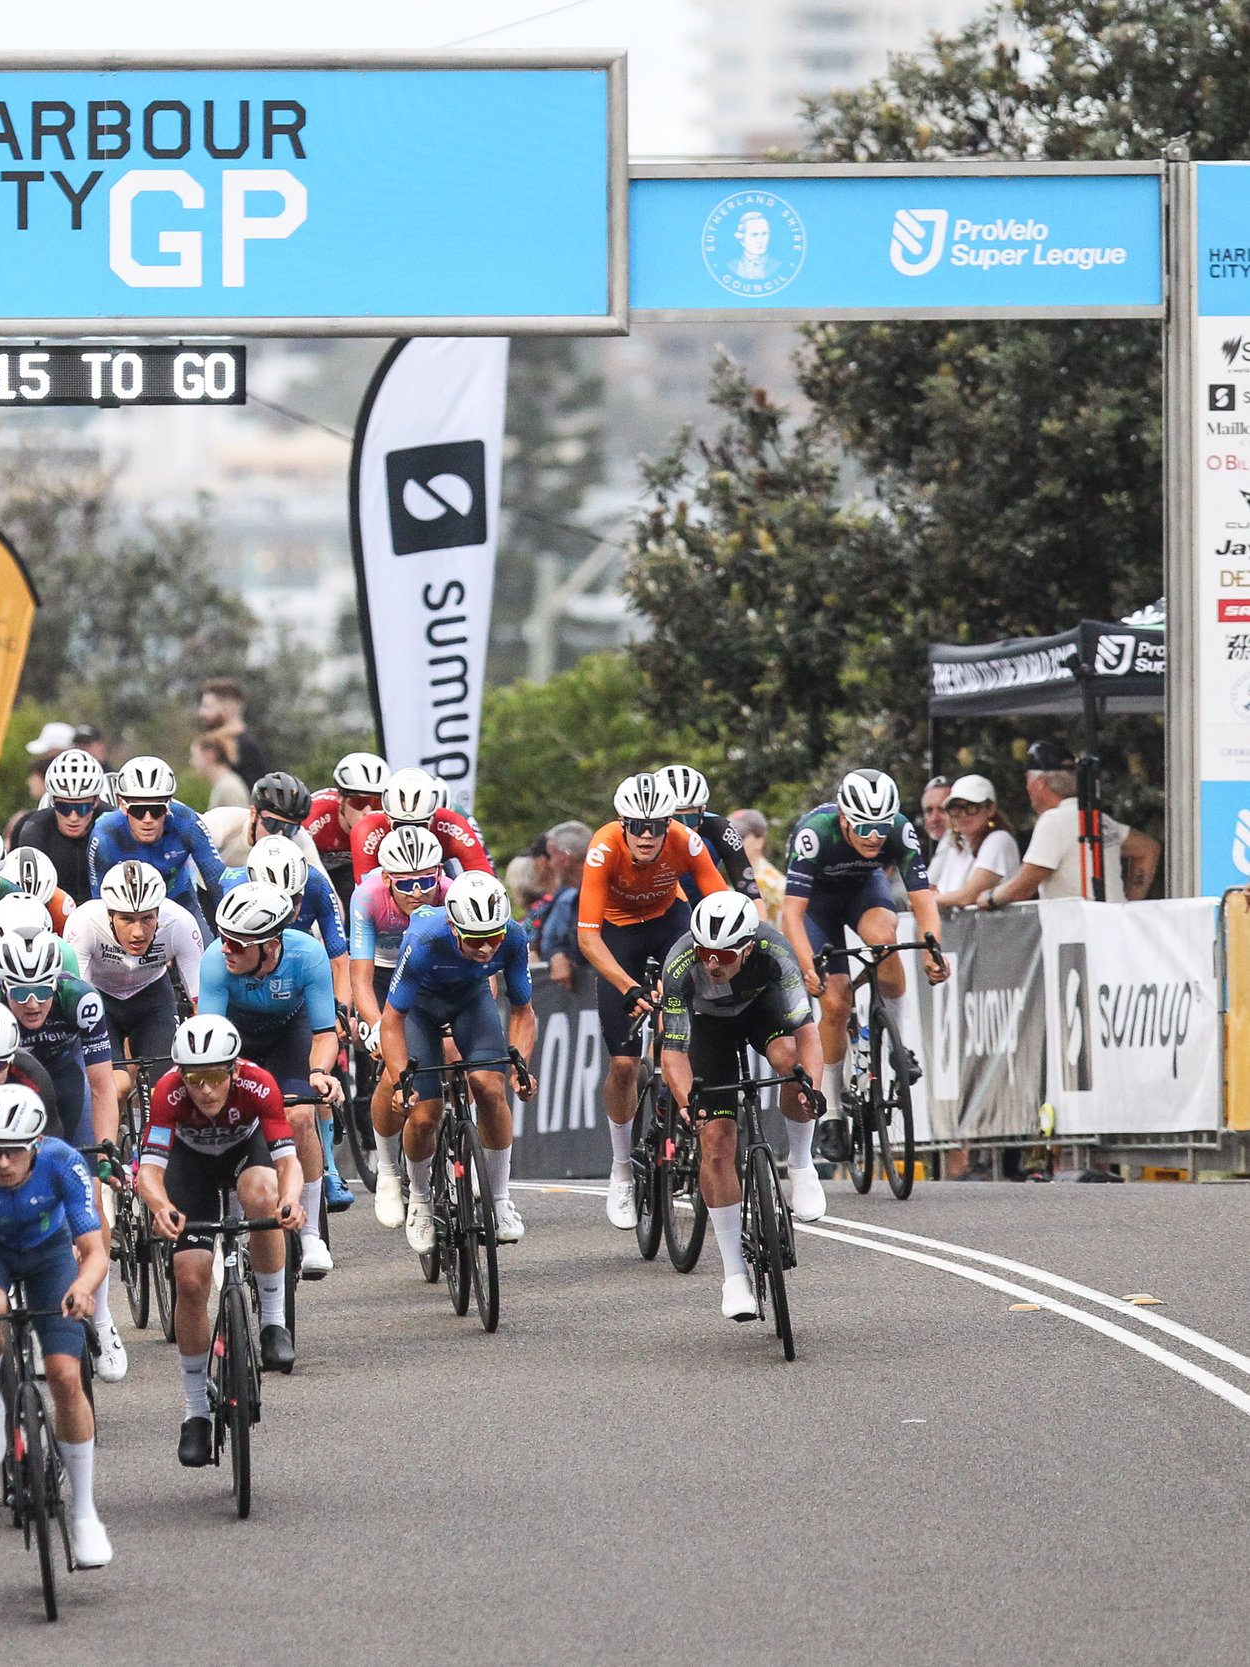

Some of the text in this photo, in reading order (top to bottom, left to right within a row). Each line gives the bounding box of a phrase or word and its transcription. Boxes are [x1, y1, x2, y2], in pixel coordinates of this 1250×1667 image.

[109, 169, 307, 288] GP
[706, 195, 776, 252] SUTHERLAND
[953, 218, 1049, 242] ProVelo
[950, 244, 1127, 270] Super League
[1209, 249, 1250, 262] HAR
[721, 274, 788, 293] COUNCIL
[81, 353, 143, 400] TO
[174, 353, 235, 400] GO
[1138, 641, 1166, 657] Pro
[421, 579, 470, 783] sumup
[437, 821, 476, 847] COBRA9
[389, 944, 413, 995] SHIMANO
[666, 948, 694, 975] FOCUS
[964, 987, 1025, 1085] sumup
[1099, 981, 1193, 1079] sumup
